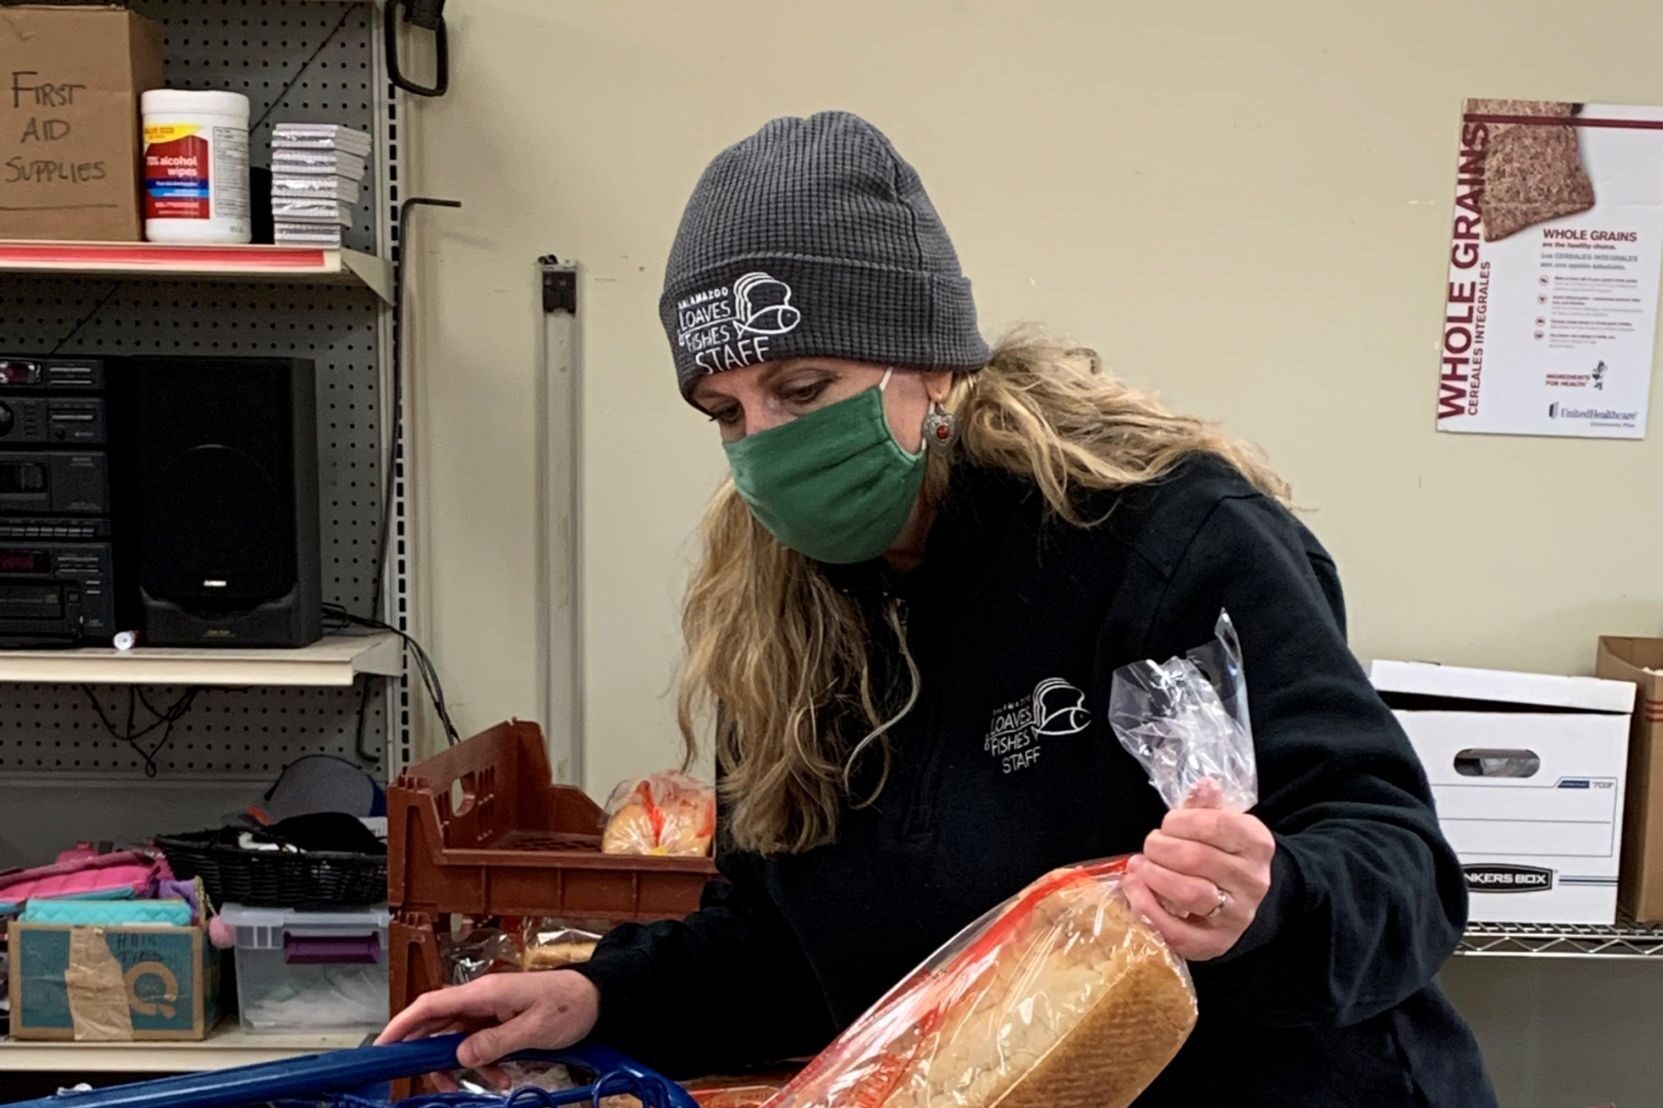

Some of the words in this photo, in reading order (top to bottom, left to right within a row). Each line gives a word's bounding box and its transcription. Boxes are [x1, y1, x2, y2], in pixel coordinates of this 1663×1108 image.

[12, 71, 86, 108] FIRST
[21, 117, 70, 143] AID
[5, 156, 107, 183] SUPPLIES
[160, 156, 197, 166] alcohol
[168, 167, 197, 178] wipes
[1451, 122, 1489, 269] GRAINS
[1543, 229, 1587, 240] WHOLE
[1590, 230, 1637, 242] GRAINS
[679, 300, 731, 331] LOAVES
[1474, 261, 1491, 345] INTEGRALES
[685, 324, 730, 352] FISHES
[1438, 282, 1476, 419] WHOLE
[695, 336, 769, 375] STAFF
[1468, 347, 1484, 416] CEREALES
[990, 706, 1032, 735] LOAVES
[1002, 746, 1041, 774] STAFF
[1464, 873, 1513, 884] NKERS
[1515, 873, 1546, 884] BOX
